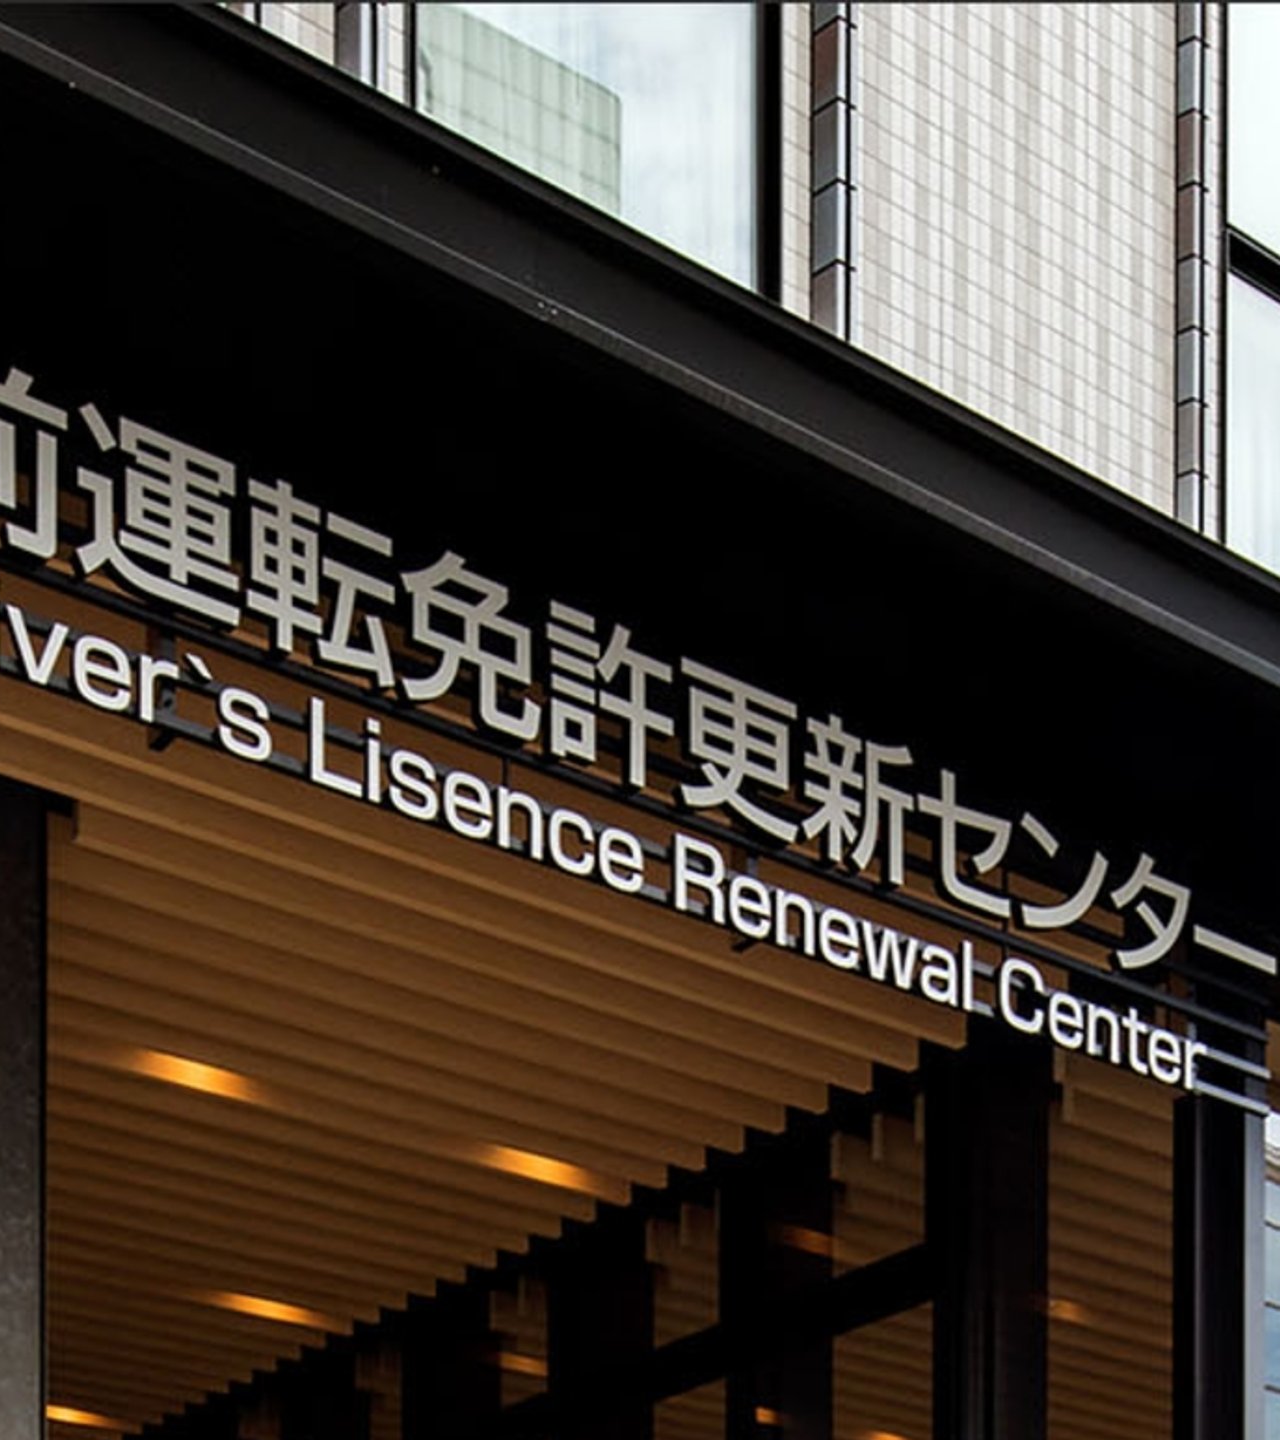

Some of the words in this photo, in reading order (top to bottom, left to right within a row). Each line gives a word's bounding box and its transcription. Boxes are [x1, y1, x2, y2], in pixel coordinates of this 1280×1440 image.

[310, 697, 645, 893] Lisence
[674, 832, 974, 1010] Renewal
[999, 958, 1208, 1091] Center
